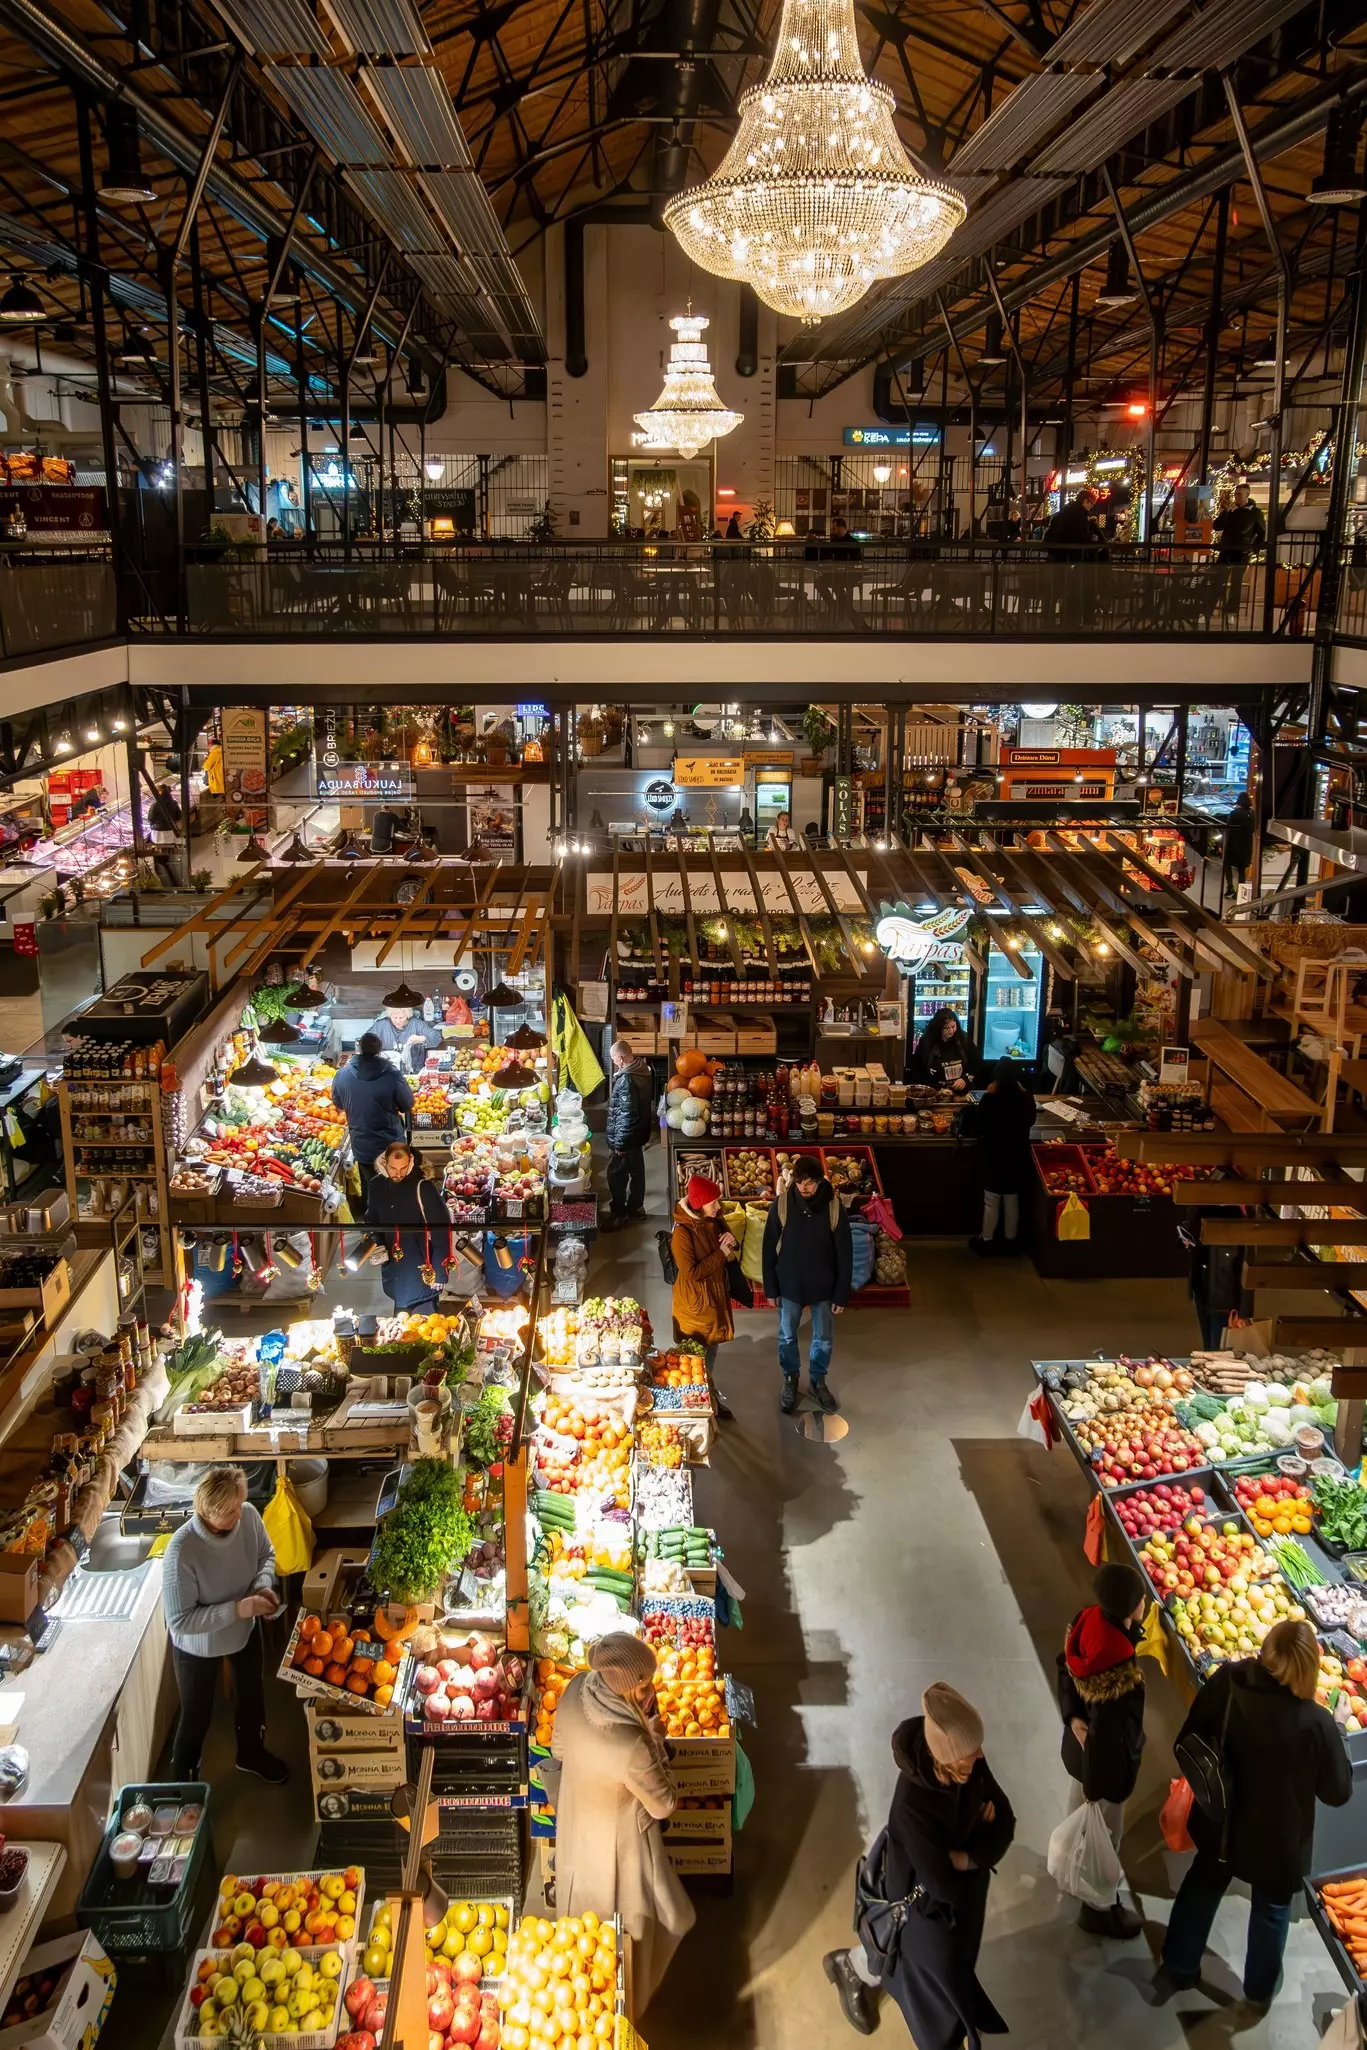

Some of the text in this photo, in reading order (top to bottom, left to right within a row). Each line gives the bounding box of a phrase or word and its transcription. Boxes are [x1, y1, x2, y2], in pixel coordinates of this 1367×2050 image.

[1028, 787, 1064, 795] zintara
[590, 890, 646, 914] Vapas
[345, 1729, 377, 1737] MONNA
[678, 1748, 709, 1756] MONNA
[348, 1766, 380, 1774] MONNA
[351, 1803, 383, 1812] MONNA
